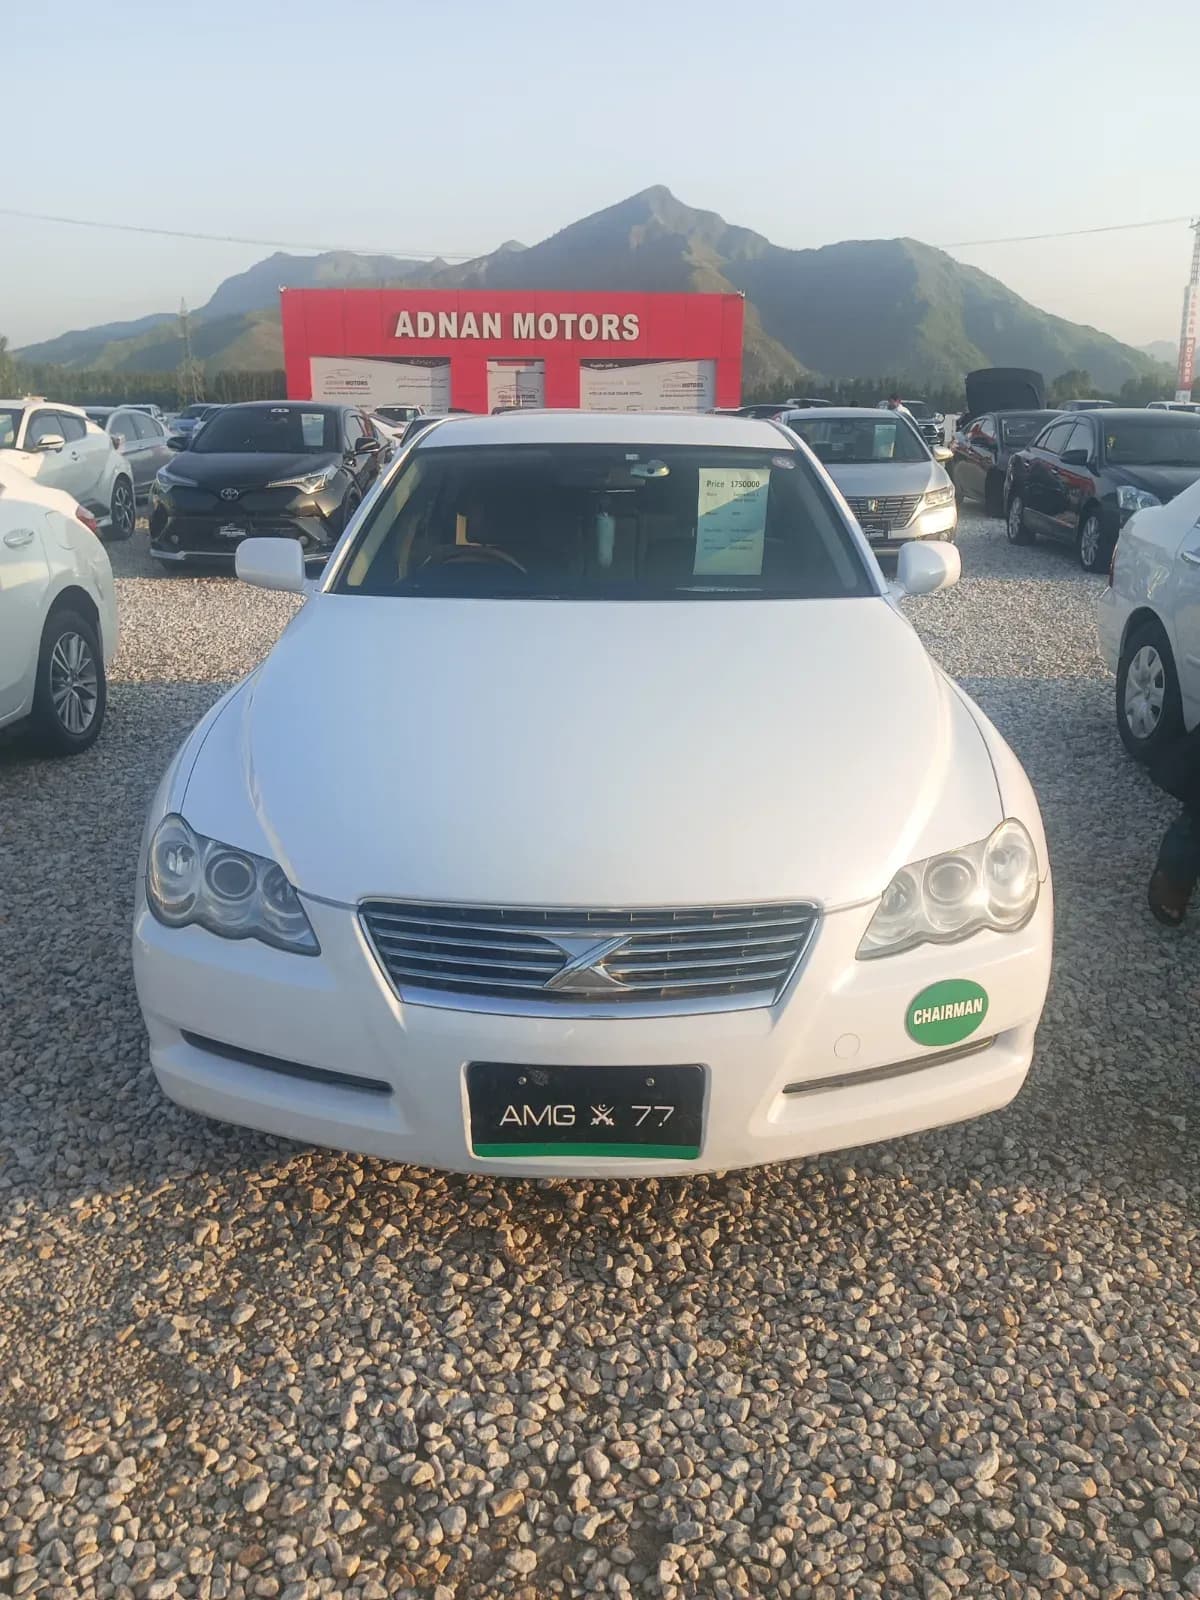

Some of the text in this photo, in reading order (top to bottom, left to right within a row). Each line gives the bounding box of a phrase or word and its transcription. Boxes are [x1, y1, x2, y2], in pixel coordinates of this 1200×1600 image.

[394, 310, 640, 340] ADNAN MOTORS
[706, 480, 760, 488] Price 1750000
[913, 997, 983, 1025] CHAIRMAN
[499, 1104, 675, 1127] AMG 77
